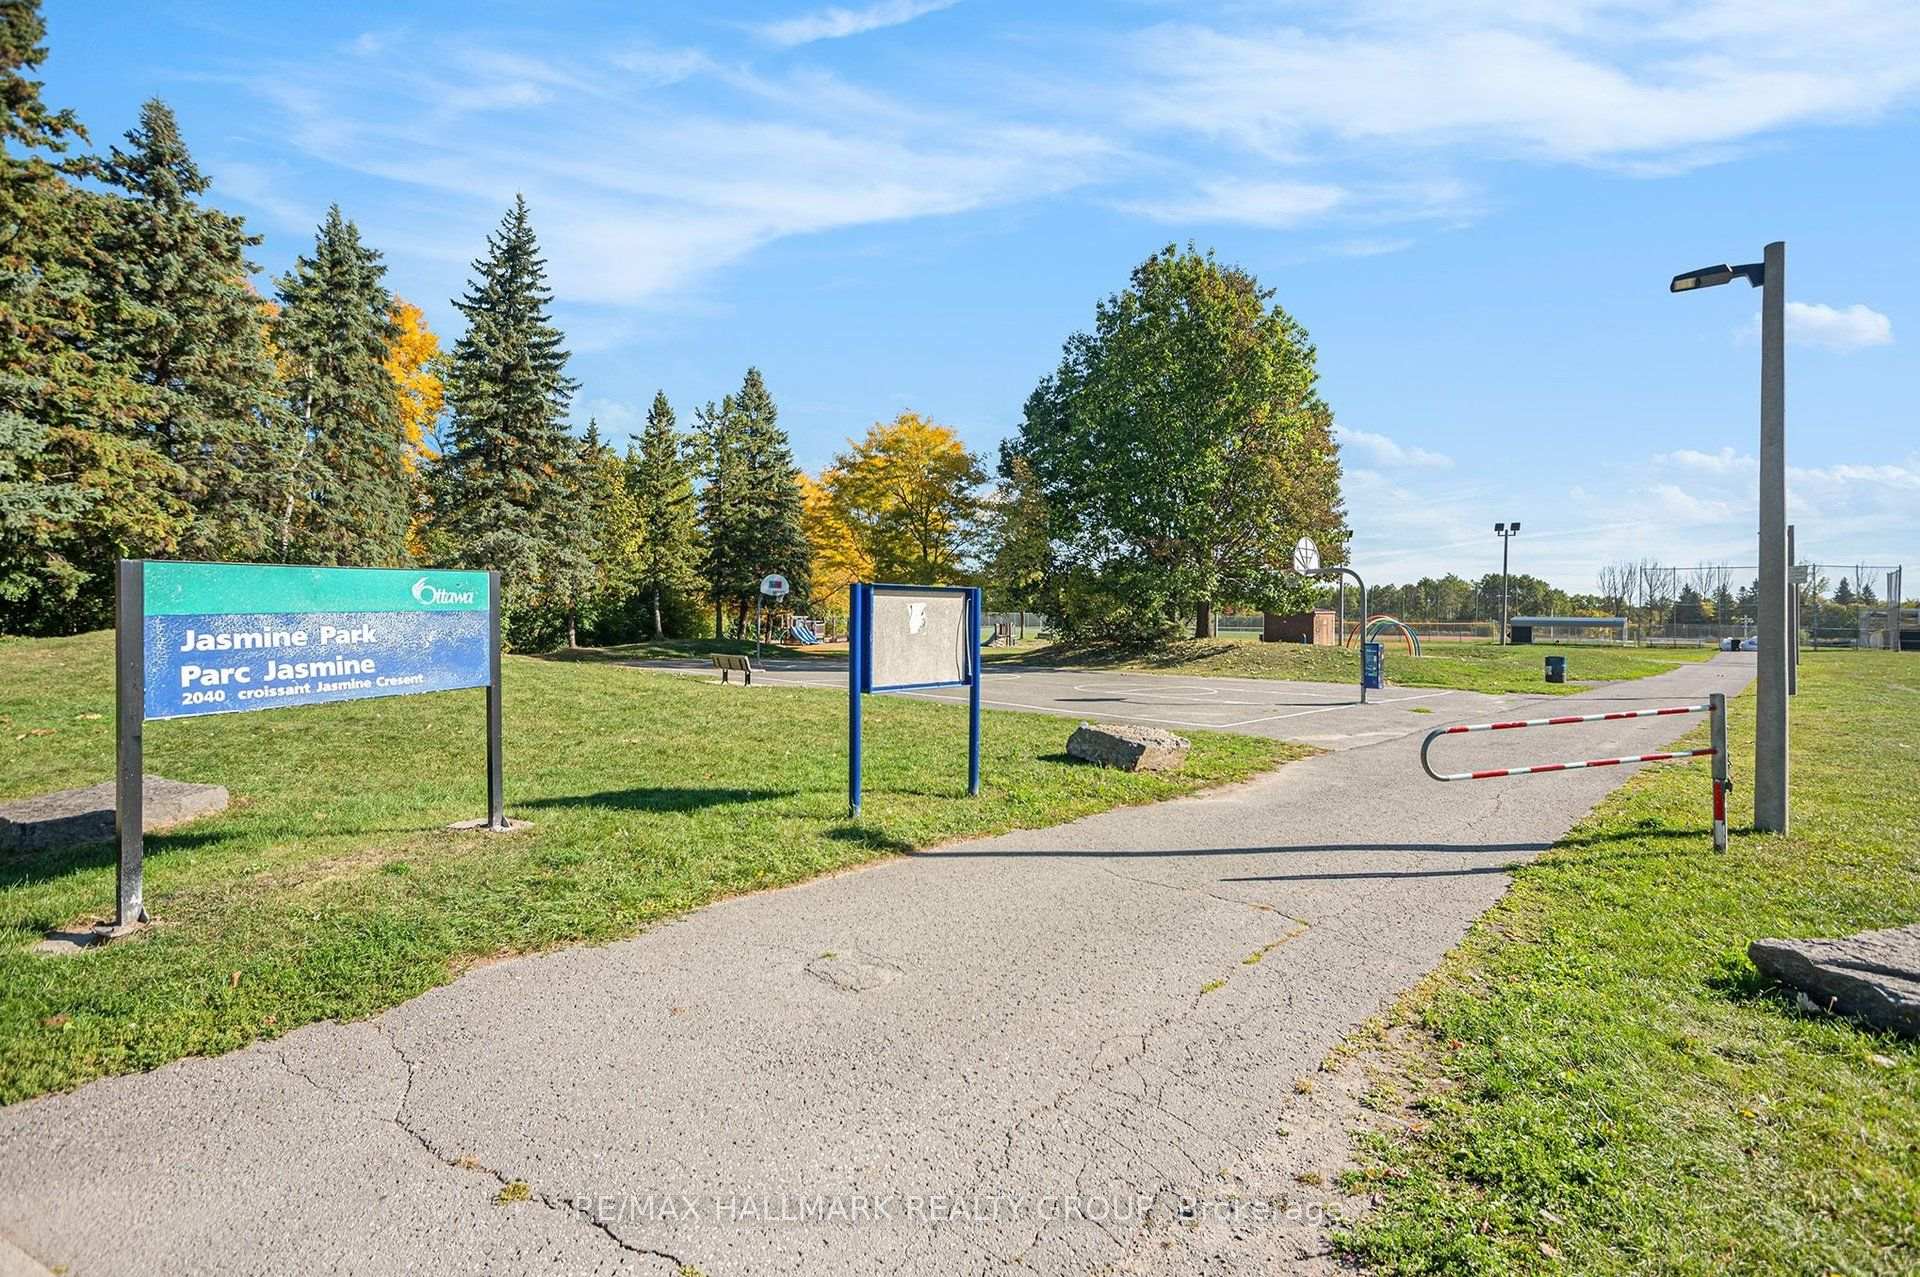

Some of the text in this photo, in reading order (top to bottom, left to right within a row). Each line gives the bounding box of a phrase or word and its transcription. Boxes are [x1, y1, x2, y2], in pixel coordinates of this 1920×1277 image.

[412, 577, 474, 604] Ottawa
[181, 624, 377, 652] Jasmine Park
[181, 655, 375, 688] Parc Jasmine
[182, 690, 225, 705] 2040
[238, 684, 310, 700] croissant
[317, 678, 371, 692] Jasmine
